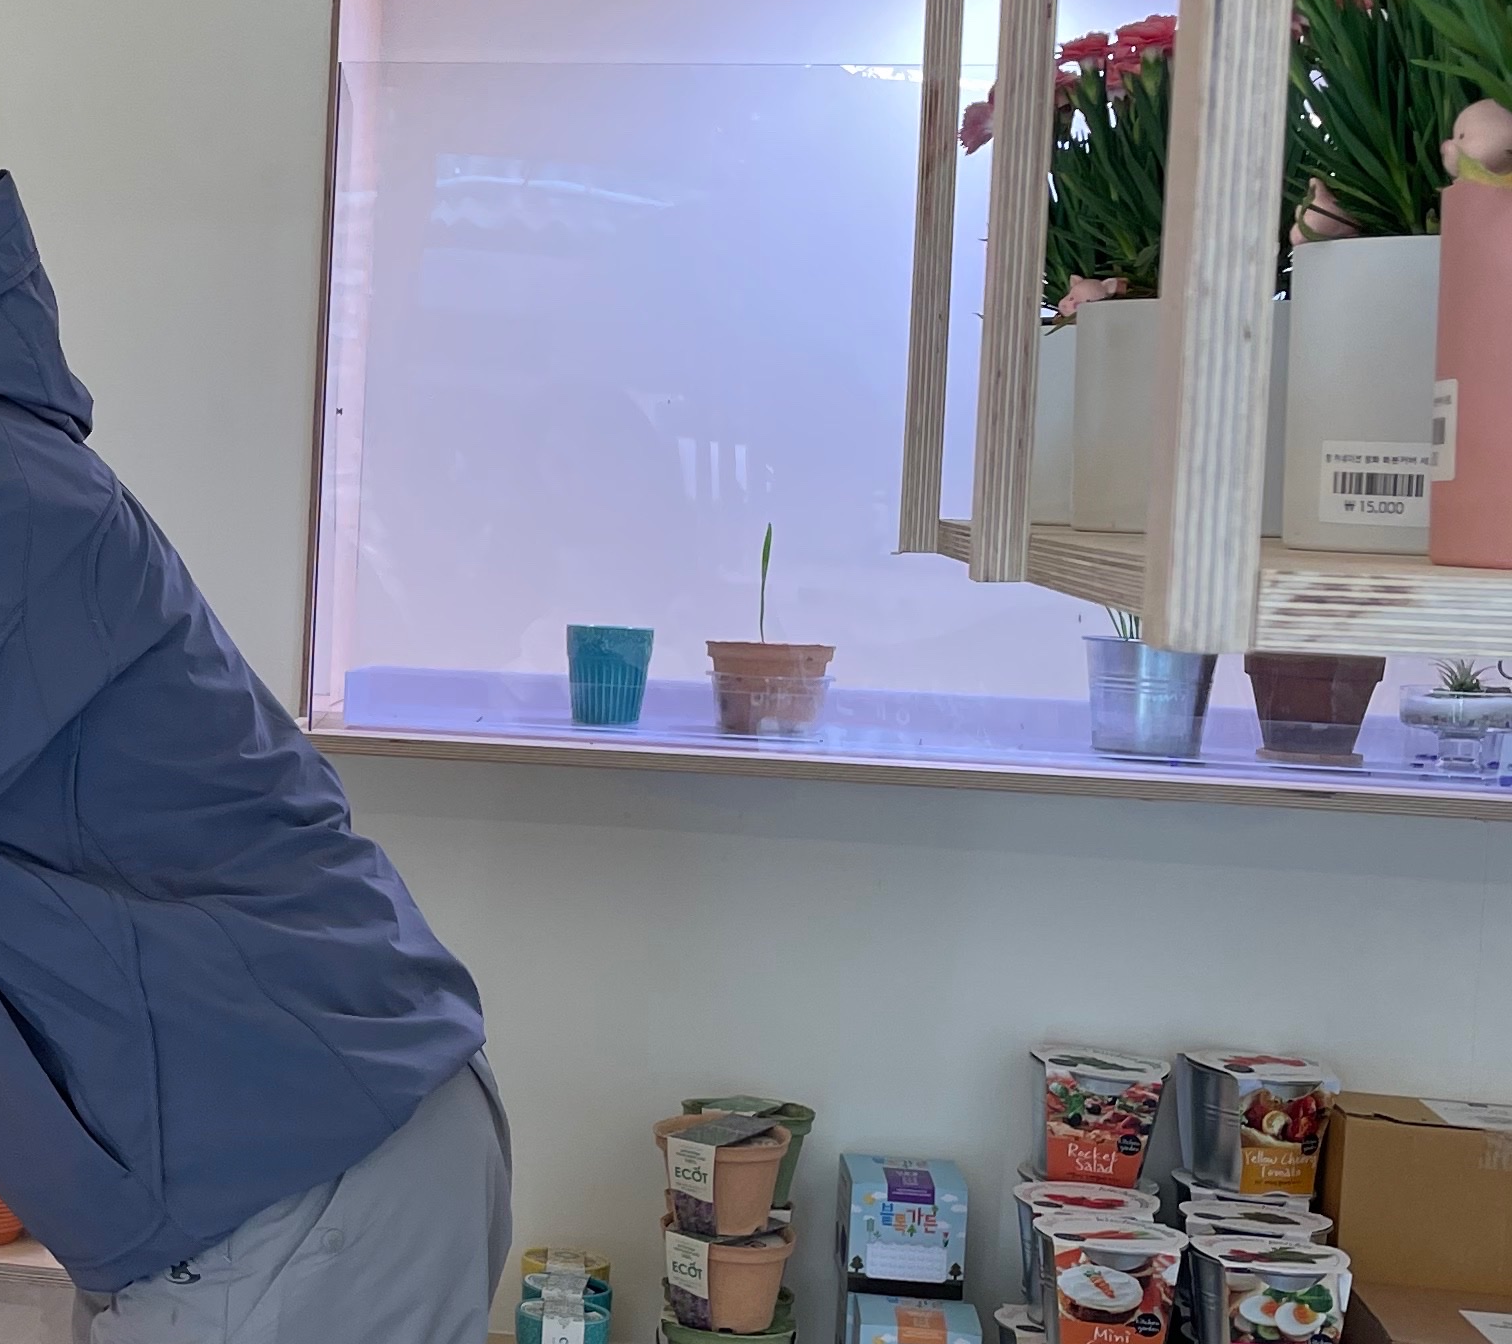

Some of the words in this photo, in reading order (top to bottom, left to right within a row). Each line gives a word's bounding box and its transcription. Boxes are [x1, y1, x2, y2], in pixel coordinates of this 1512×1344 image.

[1068, 1142, 1118, 1162] Rocket
[1245, 1150, 1278, 1165] Yellow
[1076, 1158, 1114, 1175] Salad
[1261, 1165, 1302, 1178] Tomato
[1093, 1326, 1131, 1343] Mini
